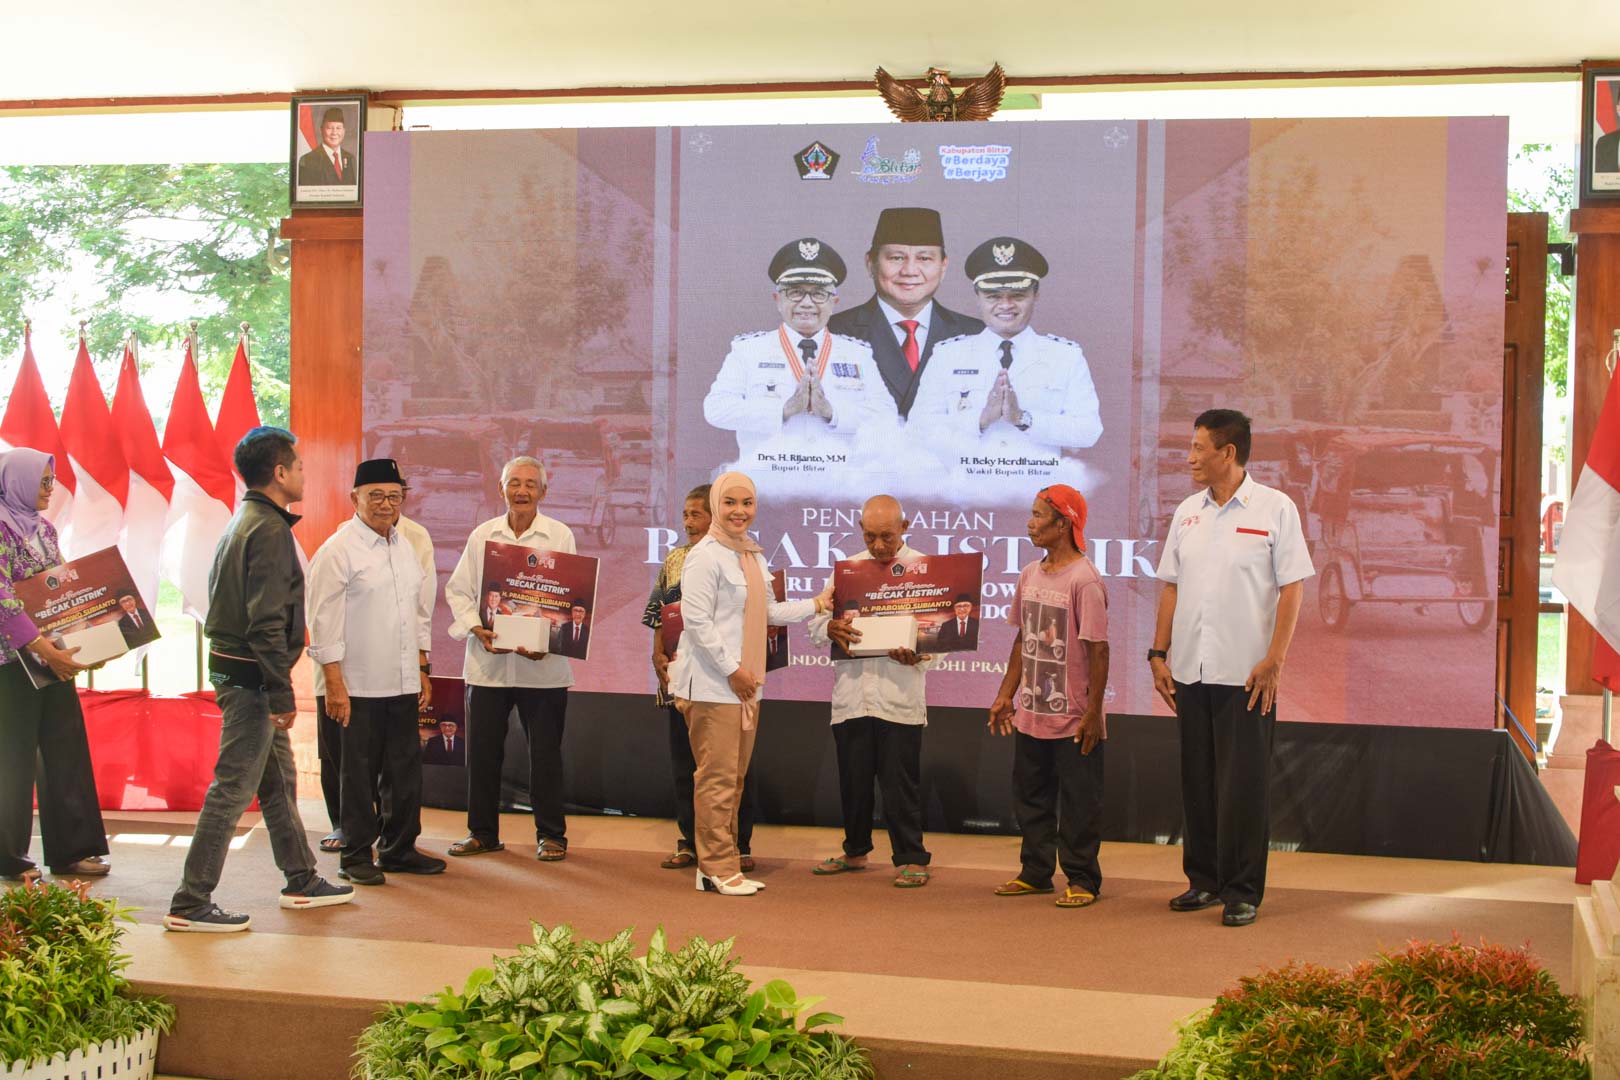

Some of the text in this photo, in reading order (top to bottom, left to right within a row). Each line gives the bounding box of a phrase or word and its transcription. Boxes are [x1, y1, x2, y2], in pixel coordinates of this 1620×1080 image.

[941, 146, 985, 154] Kabupaten
[945, 156, 1006, 166] #Berdaya
[947, 168, 1004, 179] #Berjaya
[960, 456, 970, 465] H.
[972, 456, 996, 467] Beky
[802, 507, 994, 531] PENAHAN
[643, 527, 854, 569] BAK
[865, 587, 950, 600] “BECAK LISTRIK”
[509, 592, 540, 603] PRABOWO
[540, 597, 571, 609] SUBIANTO
[871, 602, 912, 612] PRABOWO
[912, 600, 952, 610] SUBIANTO
[936, 660, 1008, 675] DHI PRAJ
